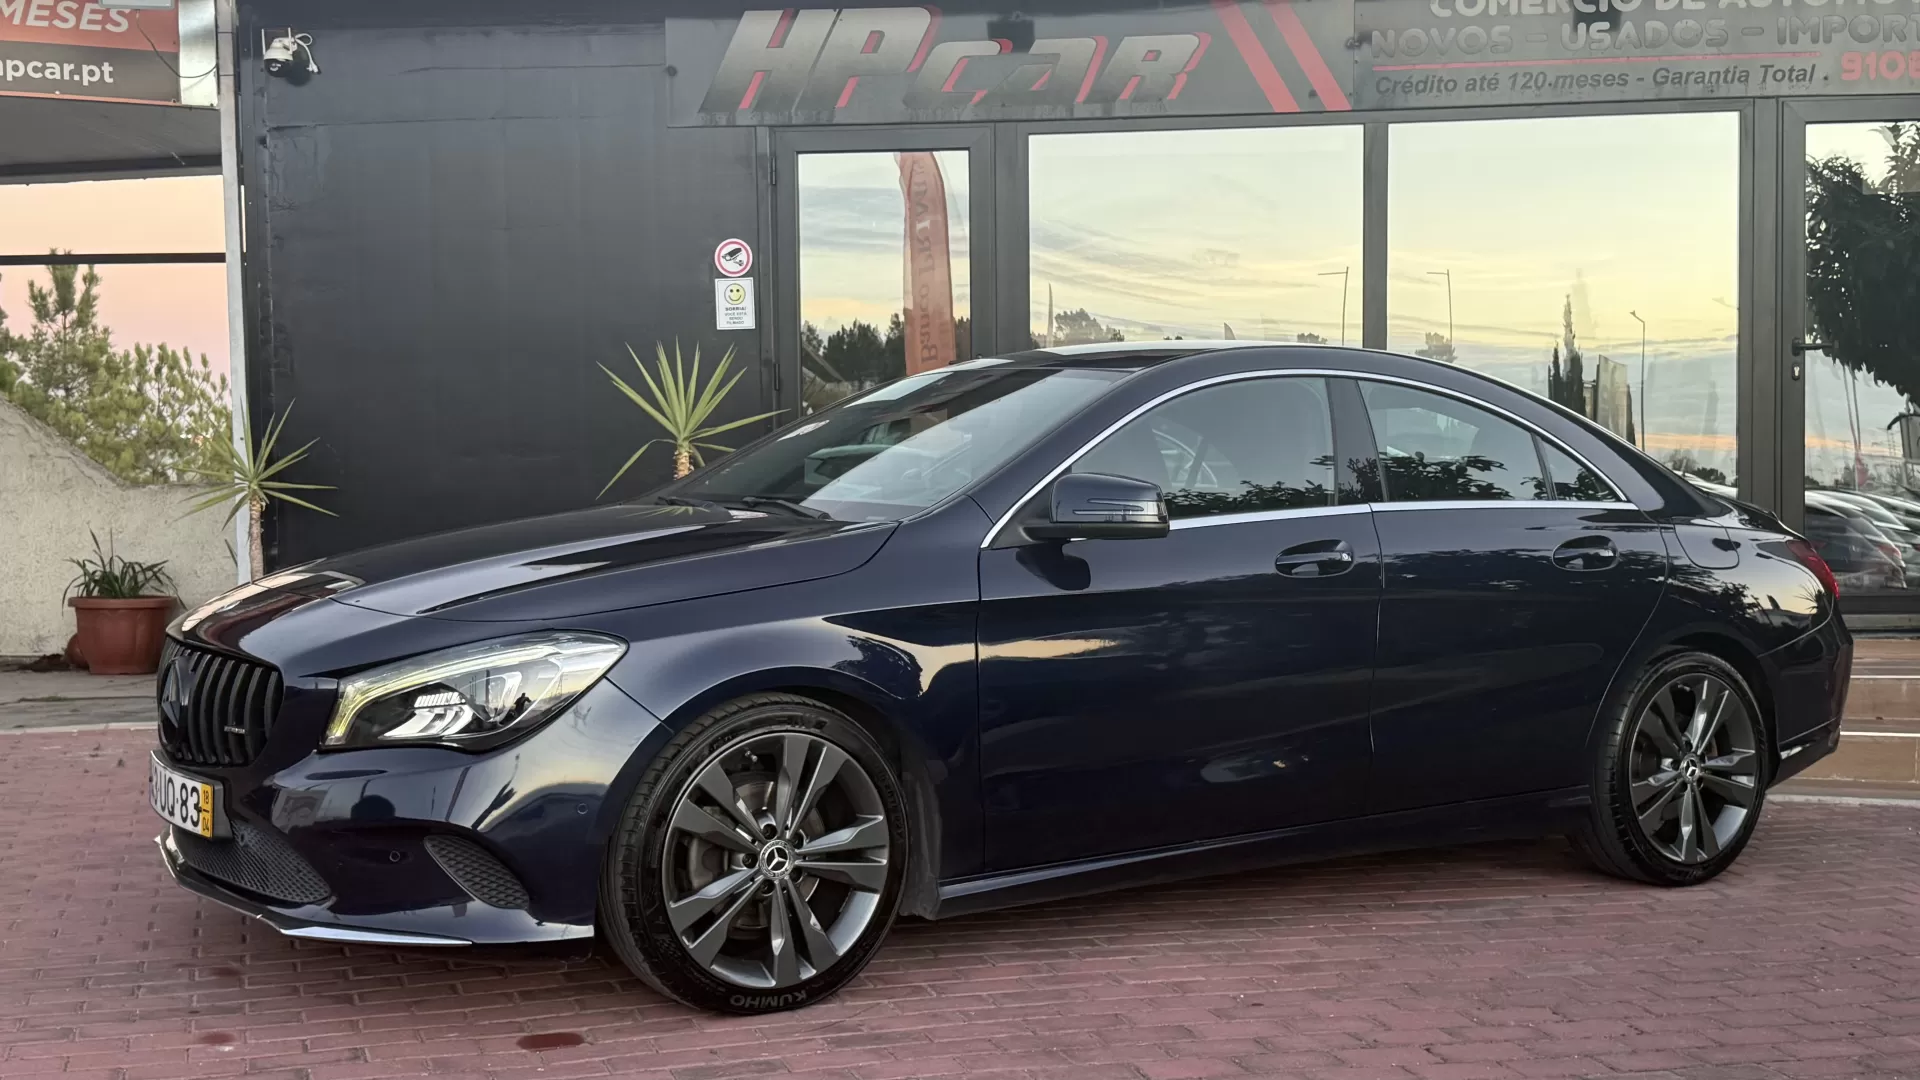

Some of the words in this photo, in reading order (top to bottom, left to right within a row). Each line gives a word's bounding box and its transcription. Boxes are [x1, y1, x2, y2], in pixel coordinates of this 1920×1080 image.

[1371, 25, 1514, 58] NOVOS
[1561, 19, 1729, 50] USADOS
[0, 58, 114, 86] pcar.pt
[1375, 74, 1458, 95] Crédito
[1465, 72, 1501, 93] até
[1652, 65, 1750, 86] Garantia
[729, 989, 807, 1009] KUMHO
